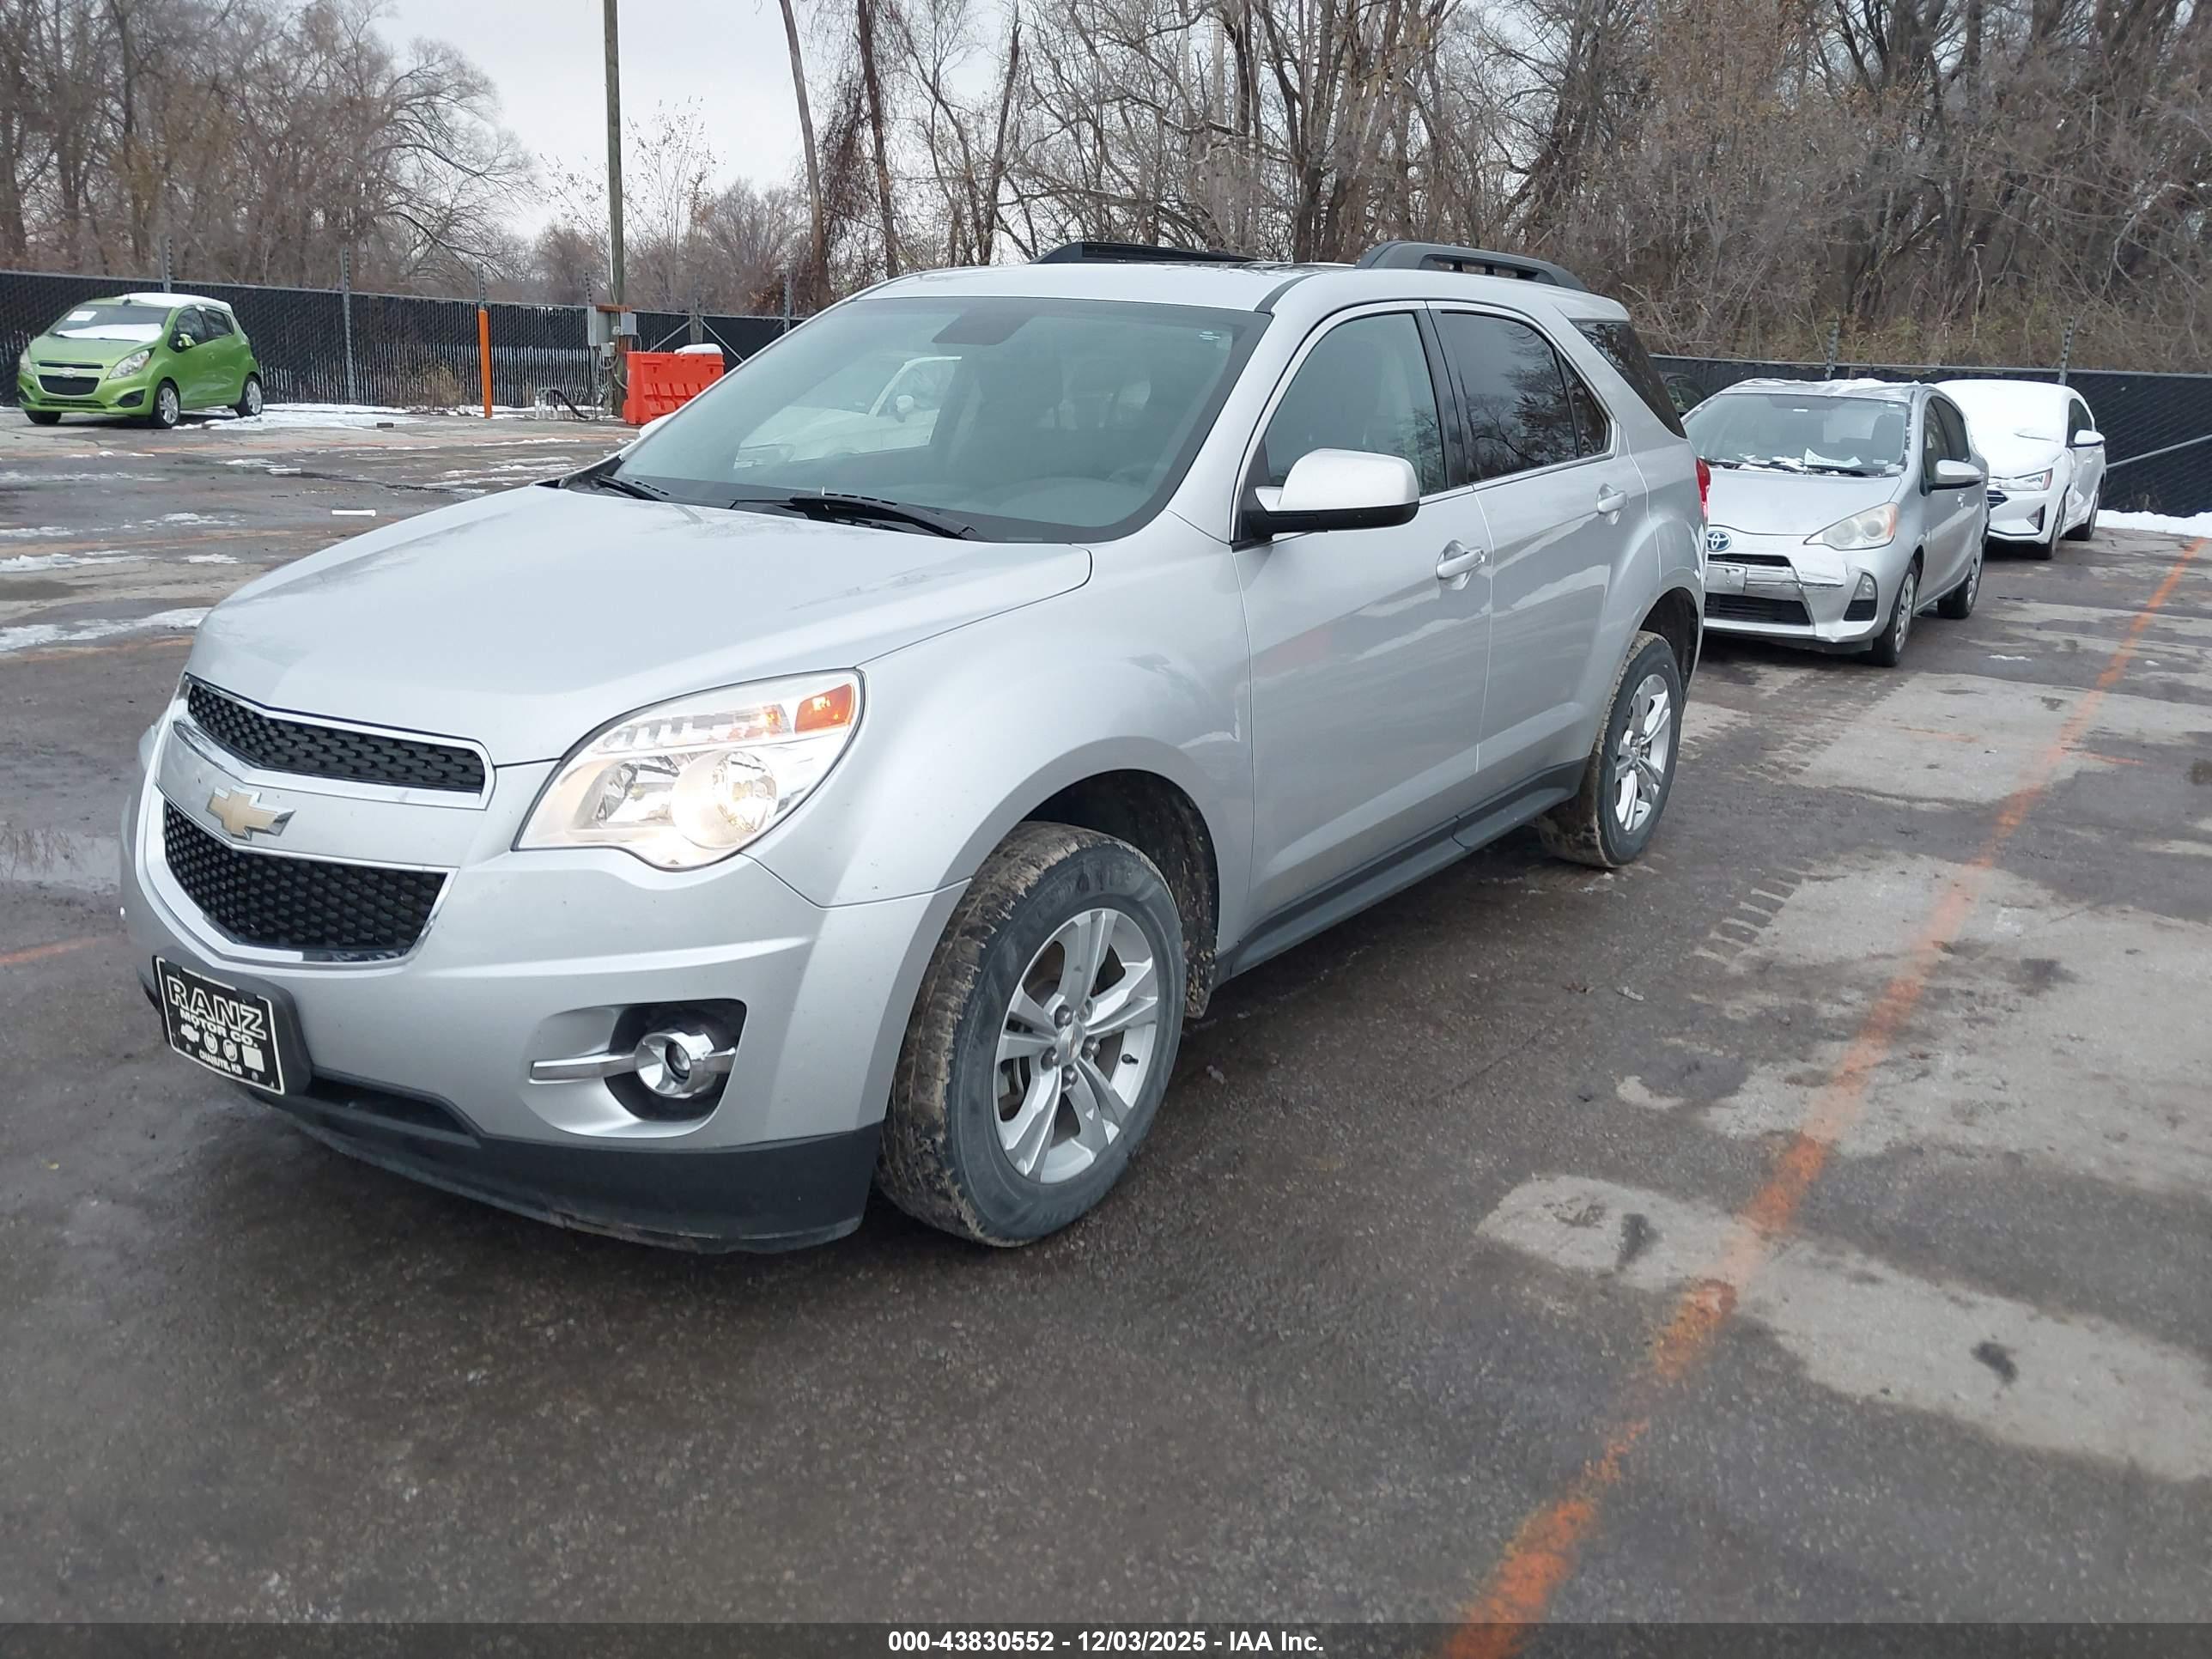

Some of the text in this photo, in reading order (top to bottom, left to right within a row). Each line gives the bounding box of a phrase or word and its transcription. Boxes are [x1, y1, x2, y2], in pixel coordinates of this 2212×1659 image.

[167, 975, 267, 1040] RANZ
[179, 1008, 258, 1048] MOTOR CO.
